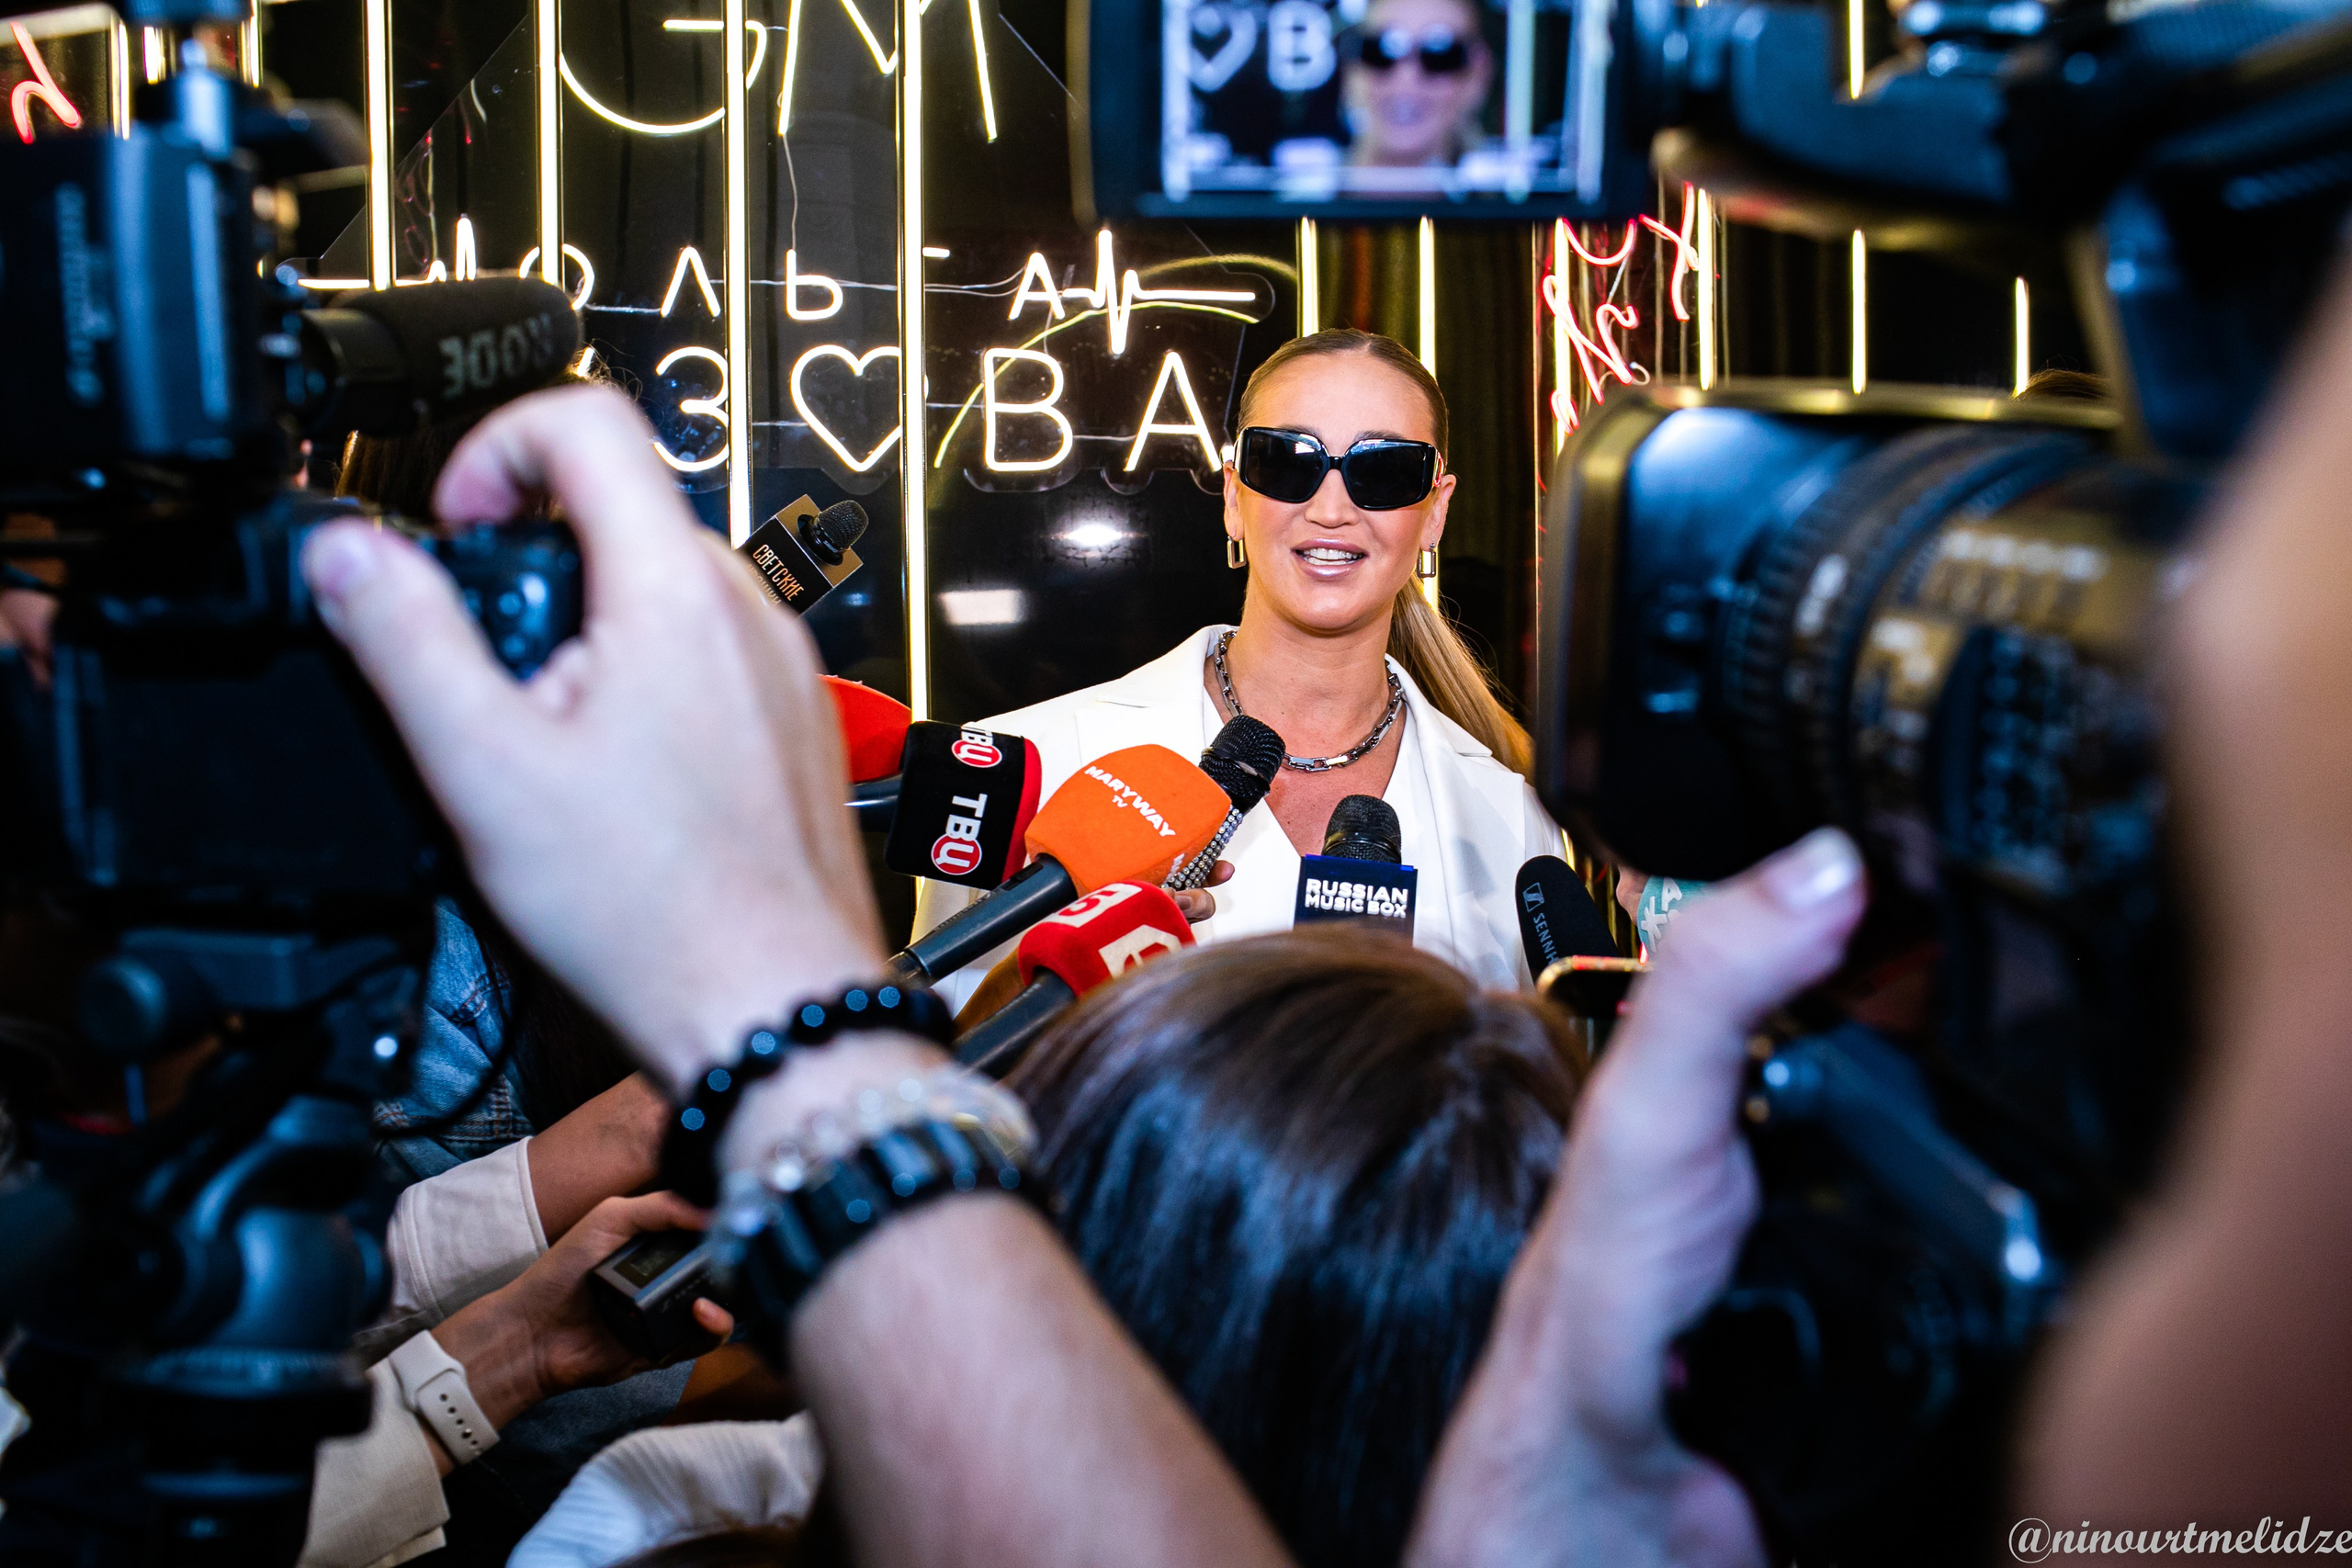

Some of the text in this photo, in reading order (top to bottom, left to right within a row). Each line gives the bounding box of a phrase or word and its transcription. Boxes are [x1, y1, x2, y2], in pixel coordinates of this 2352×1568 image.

[752, 544, 805, 602] СВЕТСКИЕ
[1084, 765, 1176, 837] MARYWAY
[1112, 795, 1128, 808] TV
[932, 793, 988, 874] ТВЦ
[1305, 878, 1408, 906] RUSSIAN
[1305, 893, 1408, 919] MUSIC BOX
